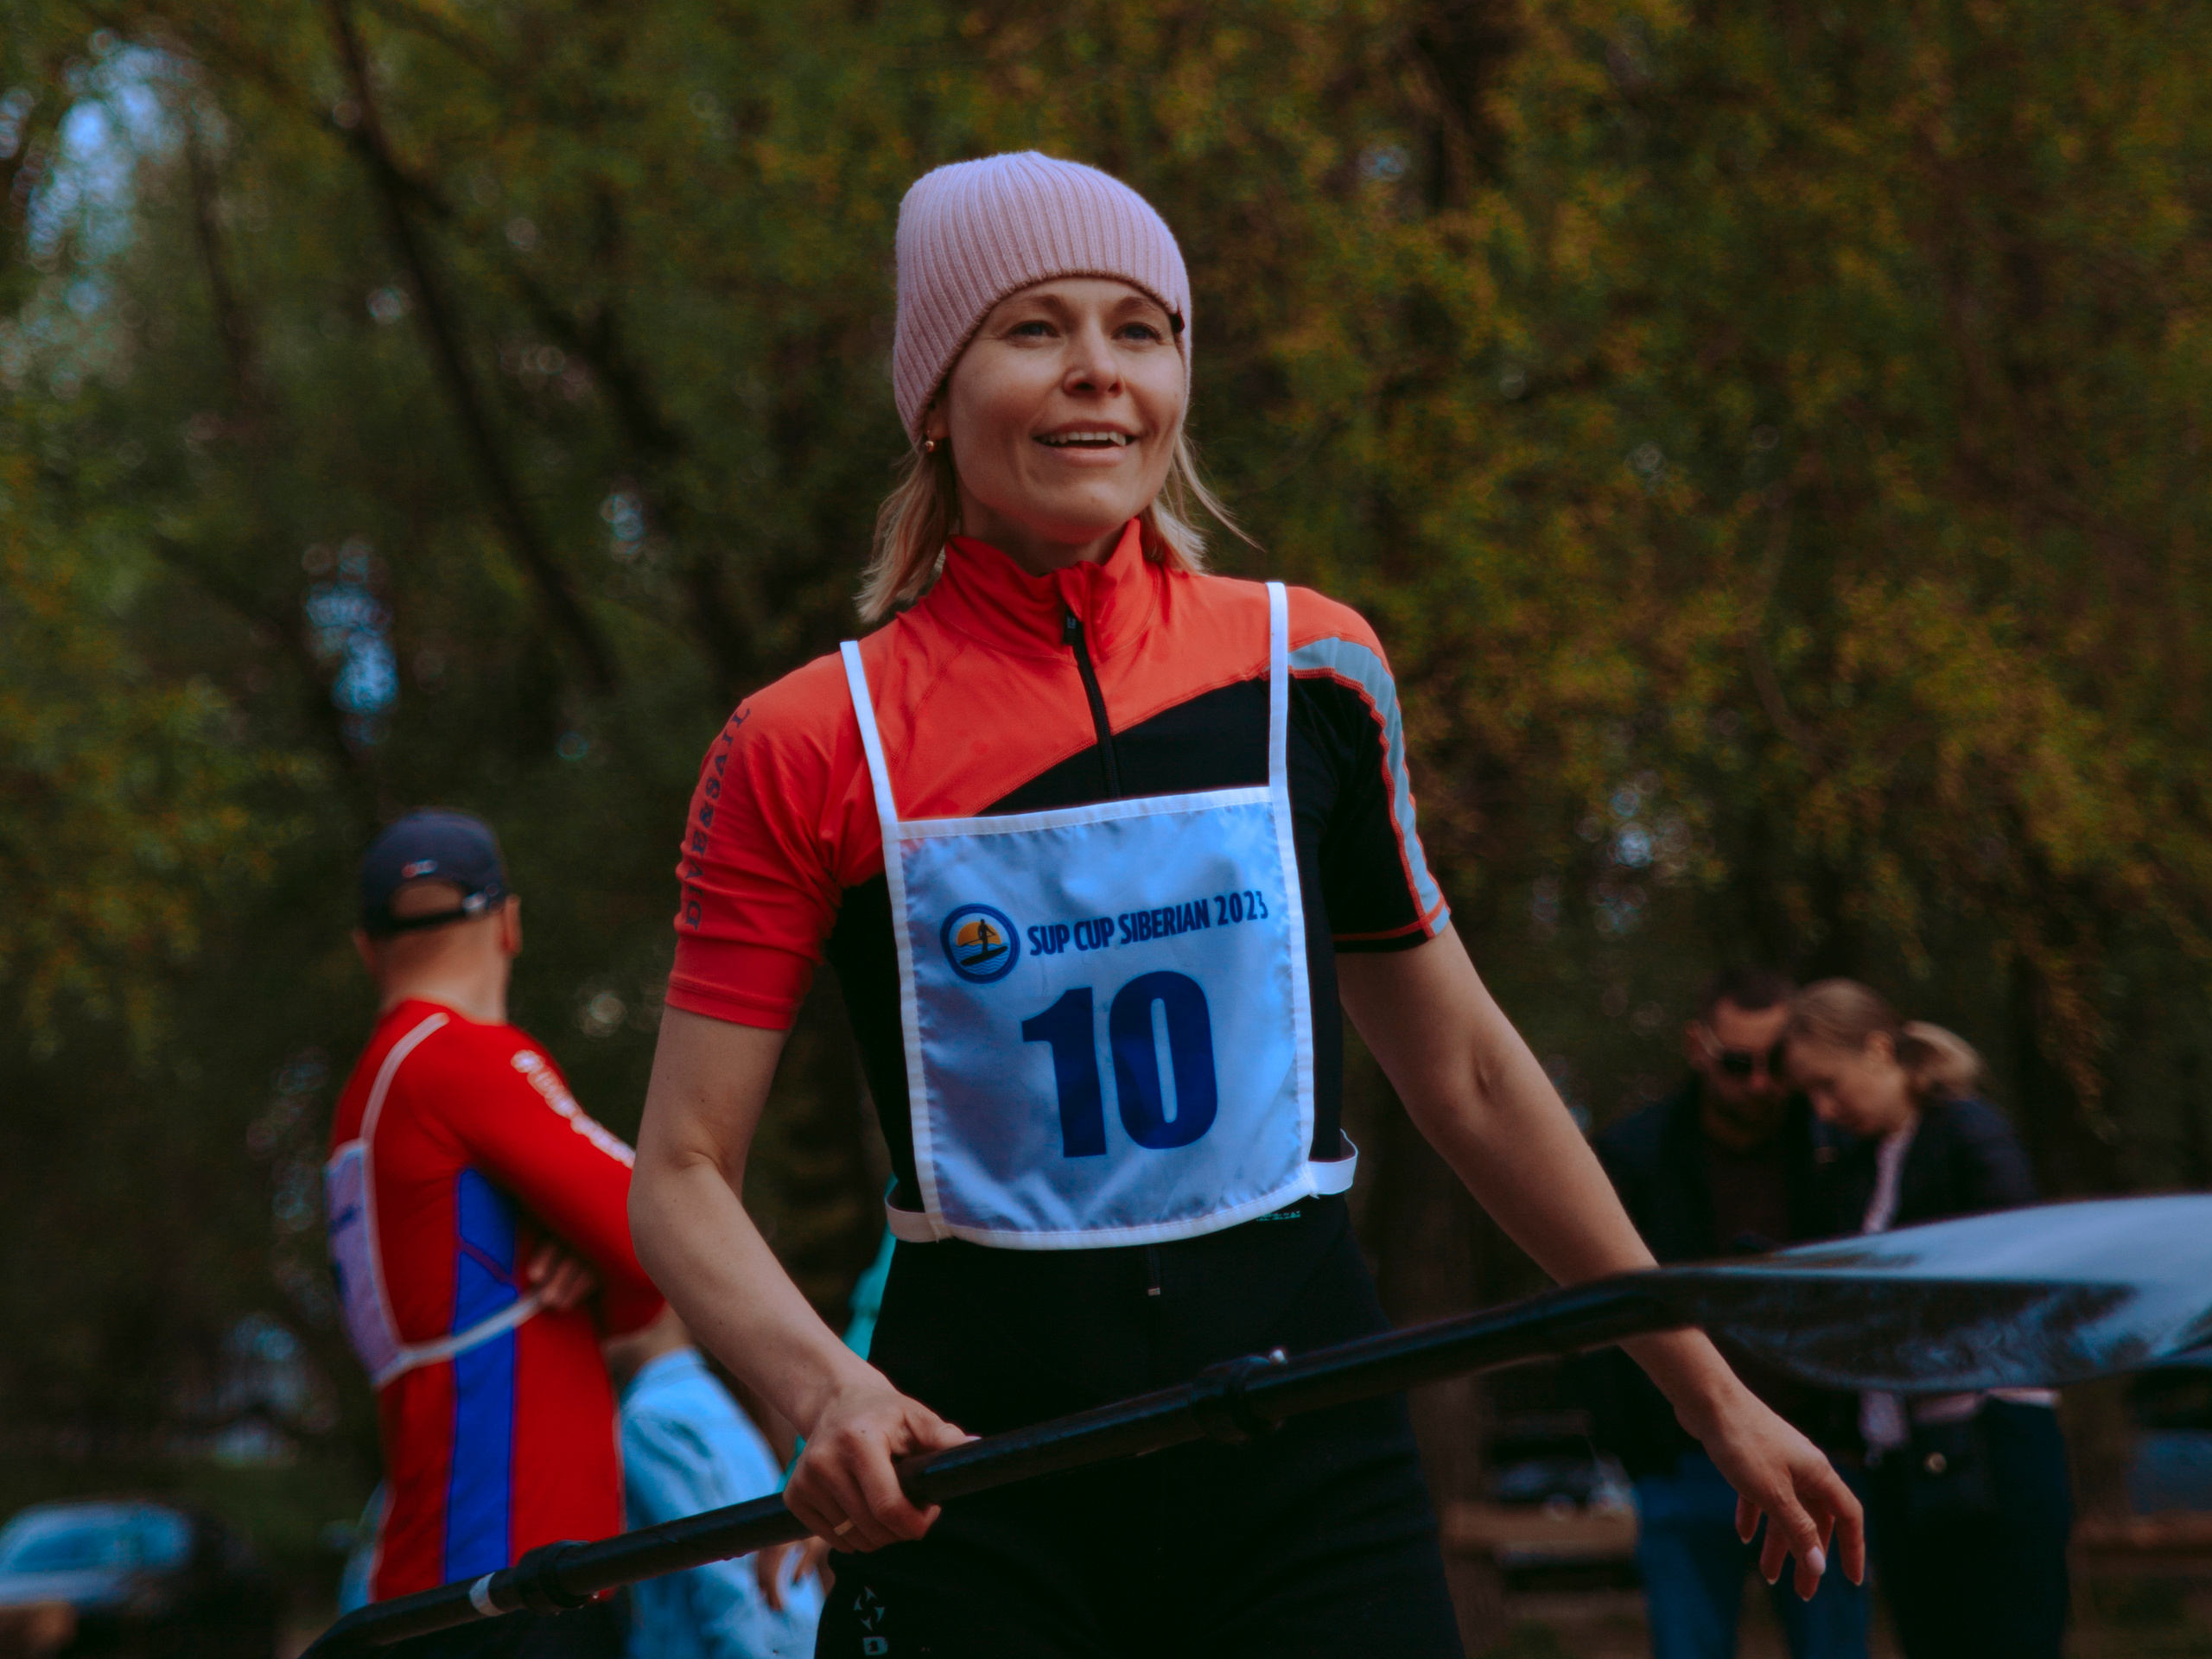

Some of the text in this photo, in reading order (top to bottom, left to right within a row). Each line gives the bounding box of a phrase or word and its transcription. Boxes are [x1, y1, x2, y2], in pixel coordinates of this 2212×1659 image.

[1027, 891, 1268, 956] SUP CUP SIBERIAN 2023
[1021, 970, 1218, 1159] 10
